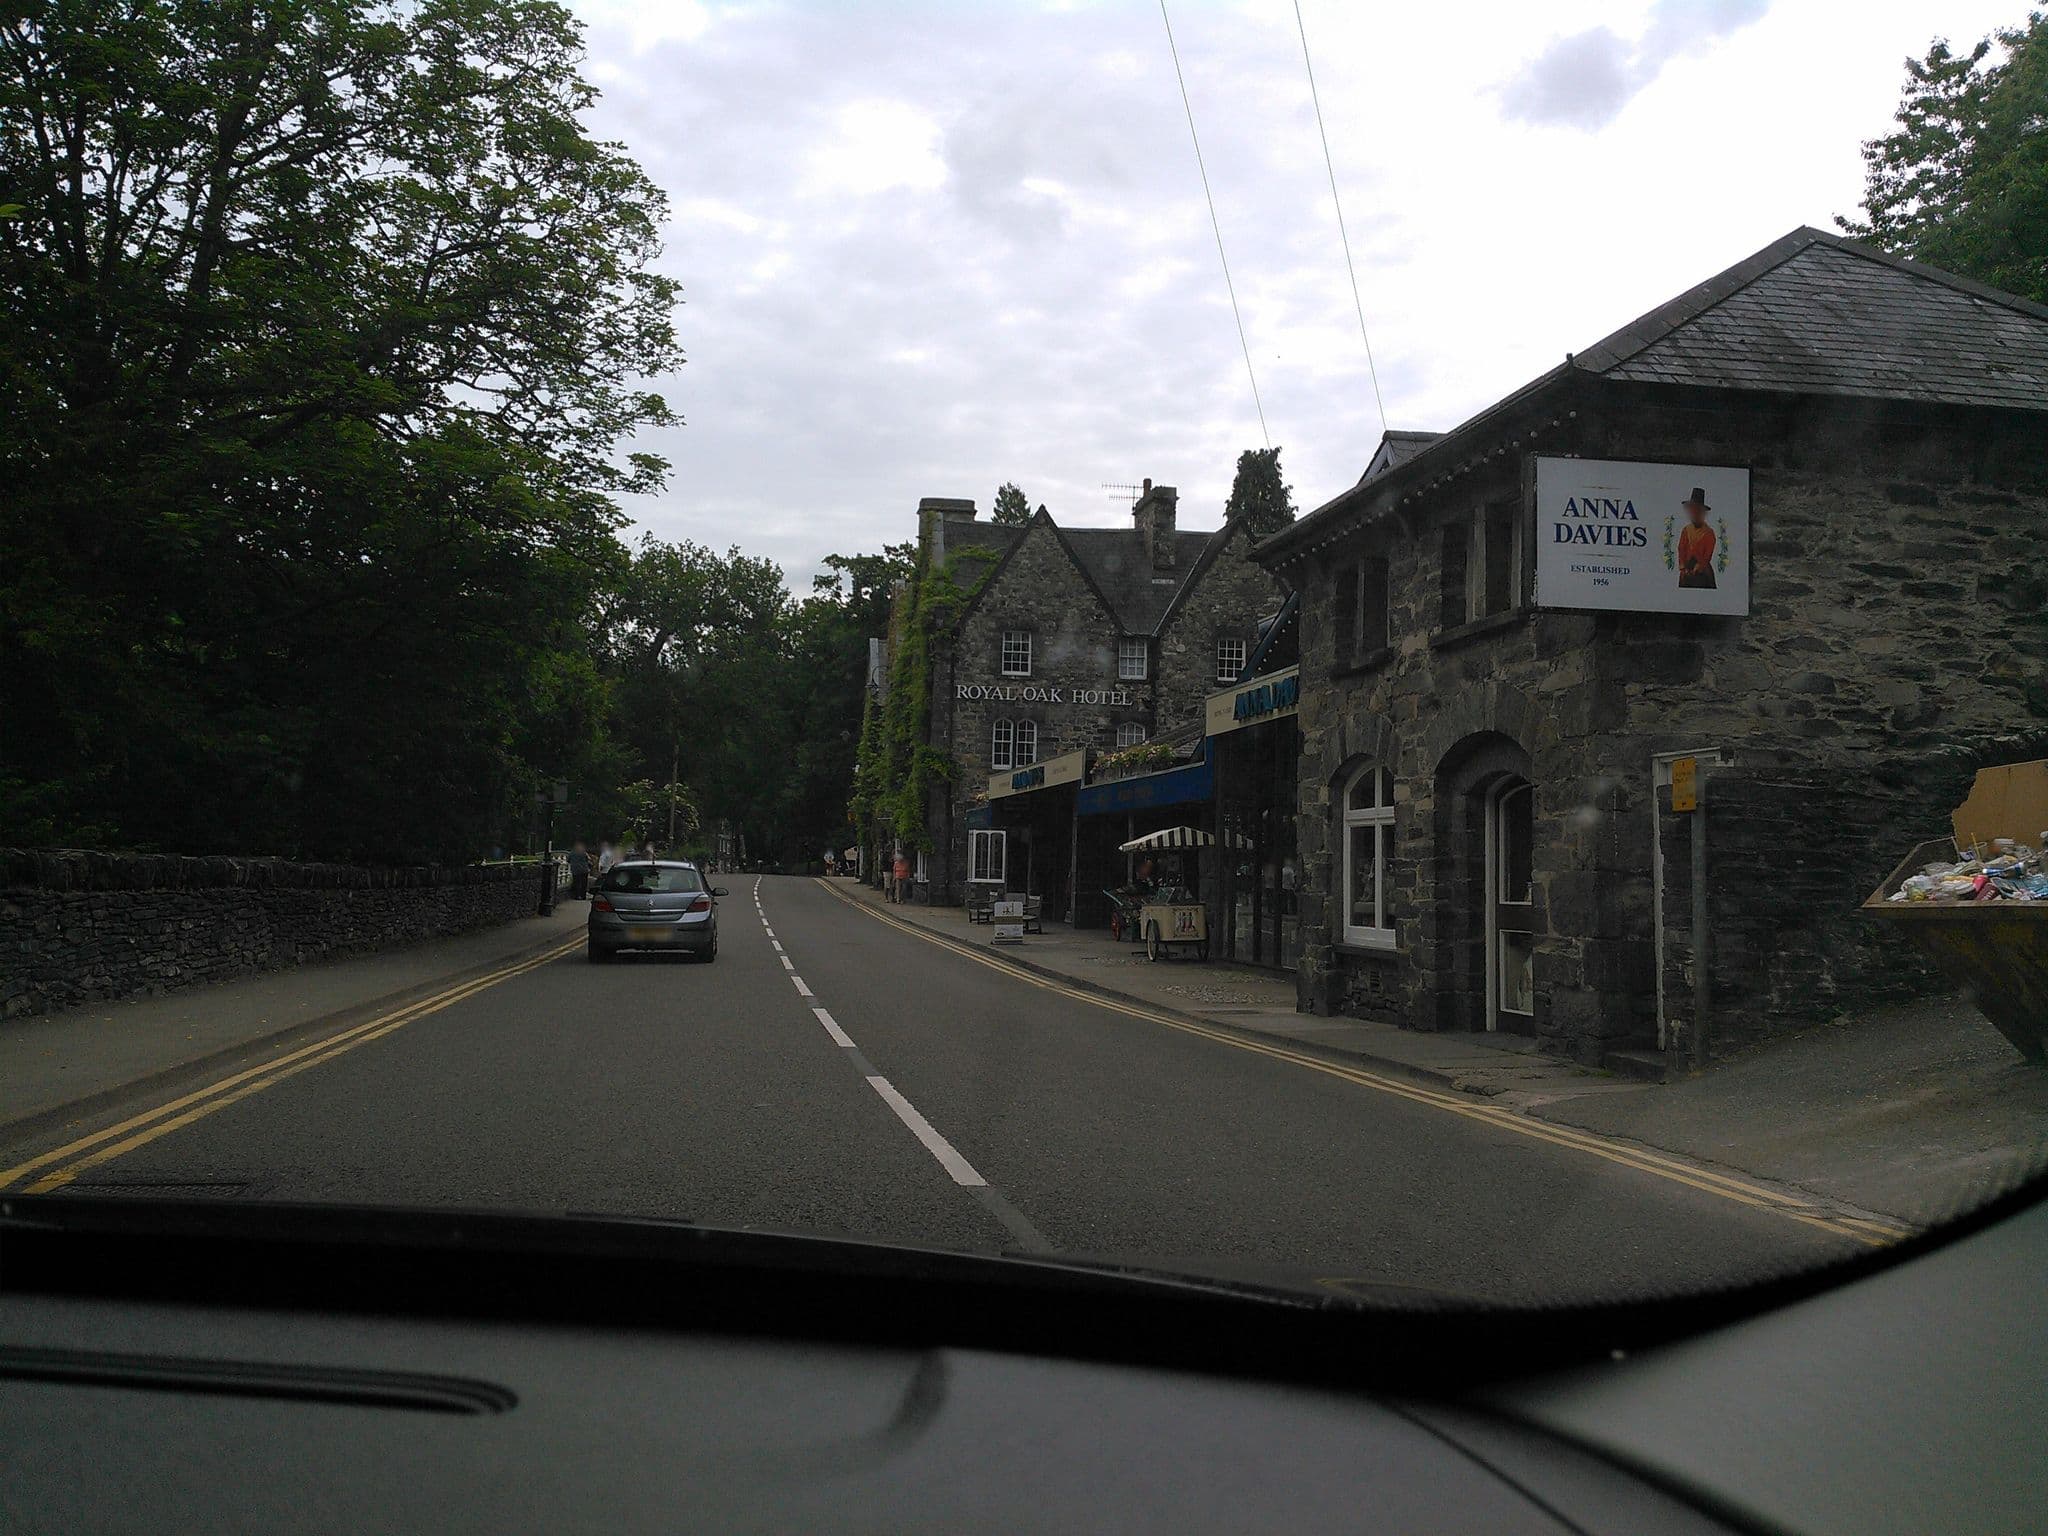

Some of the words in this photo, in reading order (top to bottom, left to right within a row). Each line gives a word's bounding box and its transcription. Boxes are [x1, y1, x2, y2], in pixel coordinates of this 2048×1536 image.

[1562, 497, 1639, 520] ANNA
[1553, 523, 1648, 548] DAVIES
[1570, 564, 1631, 575] ESTABLISHED
[1592, 578, 1610, 587] 1956
[956, 685, 1017, 701] ROYAL
[1023, 686, 1063, 703] OAK
[1072, 689, 1133, 706] HOTEL
